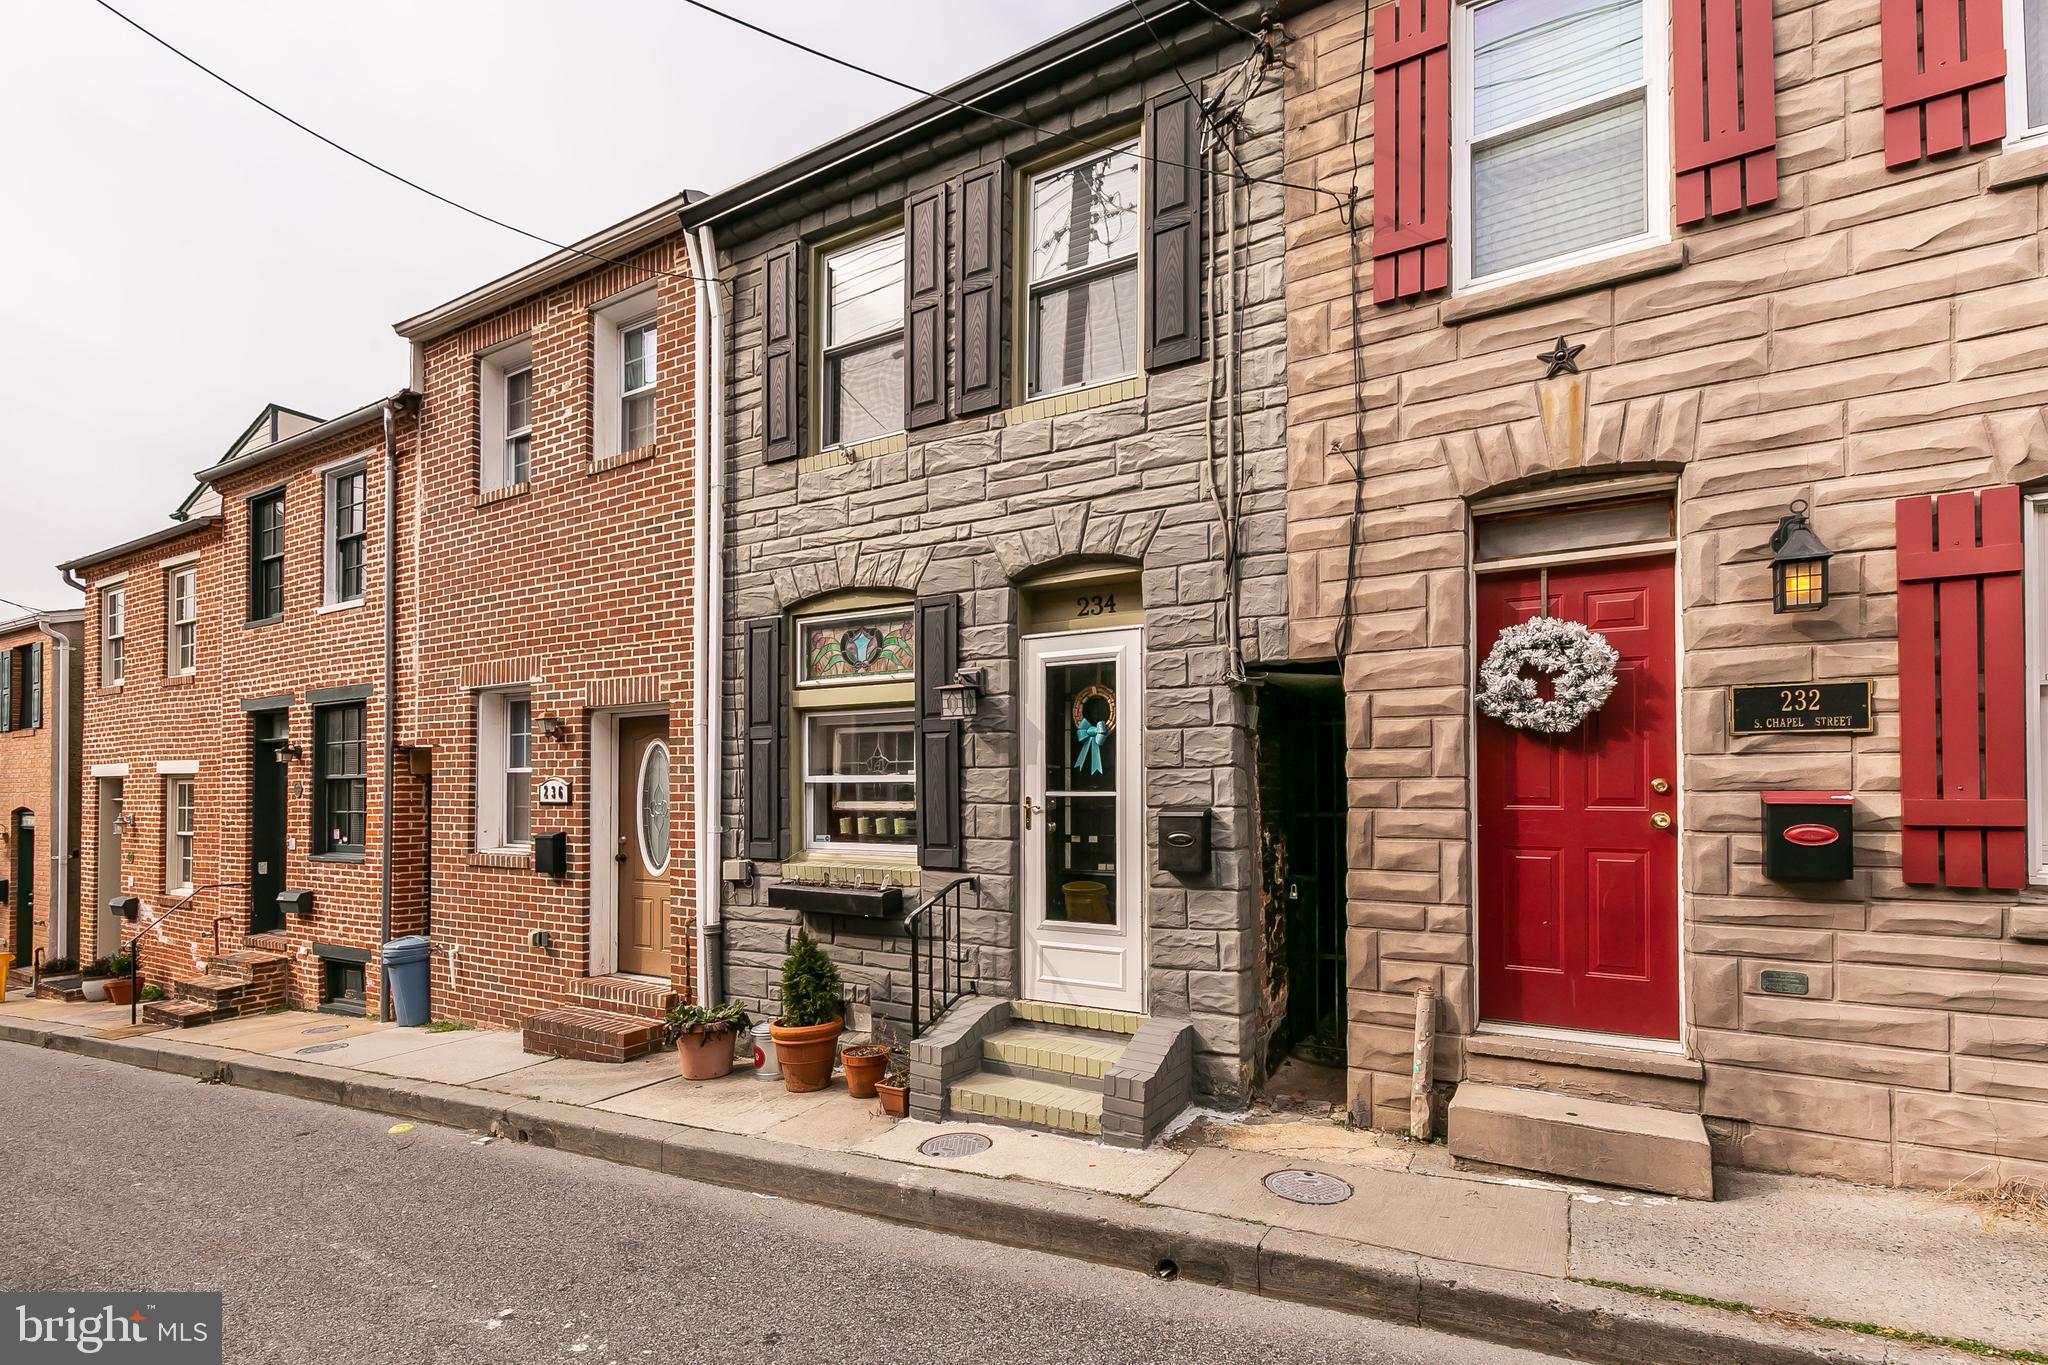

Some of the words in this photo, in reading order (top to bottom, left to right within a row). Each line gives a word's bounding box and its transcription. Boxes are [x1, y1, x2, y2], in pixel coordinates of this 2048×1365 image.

[1077, 593, 1117, 617] 234
[1780, 689, 1821, 712] 232
[1754, 718, 1763, 729] S.
[1766, 717, 1805, 728] CHAPEL
[1815, 715, 1853, 727] STREET
[543, 785, 564, 800] 236
